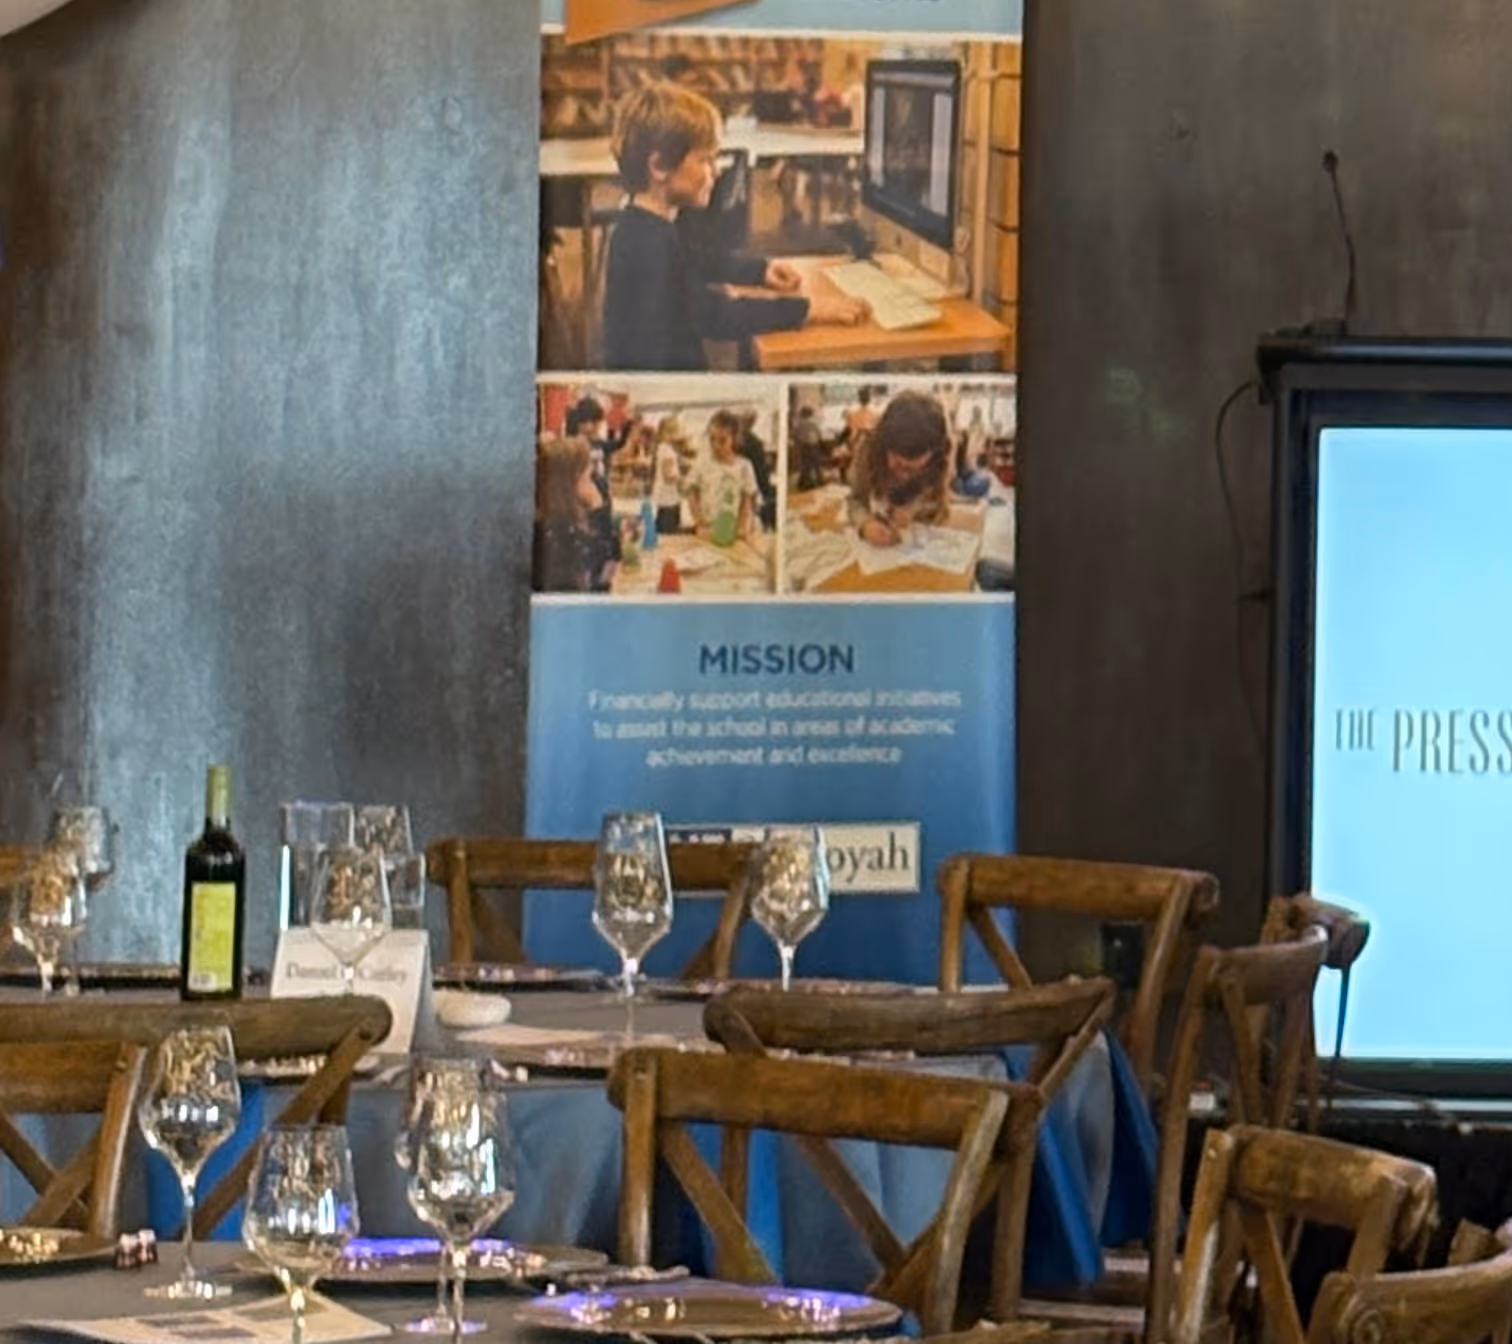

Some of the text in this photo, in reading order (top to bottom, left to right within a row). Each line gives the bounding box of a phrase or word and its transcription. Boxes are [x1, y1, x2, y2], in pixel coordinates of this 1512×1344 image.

[698, 643, 855, 675] MISSION
[689, 689, 762, 712] support
[765, 688, 870, 708] educational
[671, 718, 702, 738] the
[706, 717, 766, 738] school
[770, 718, 789, 736] in
[792, 720, 840, 737] areas
[844, 716, 865, 736] of
[868, 717, 956, 736] academic
[1334, 708, 1376, 752] THE
[645, 745, 903, 768] achievement and excellence
